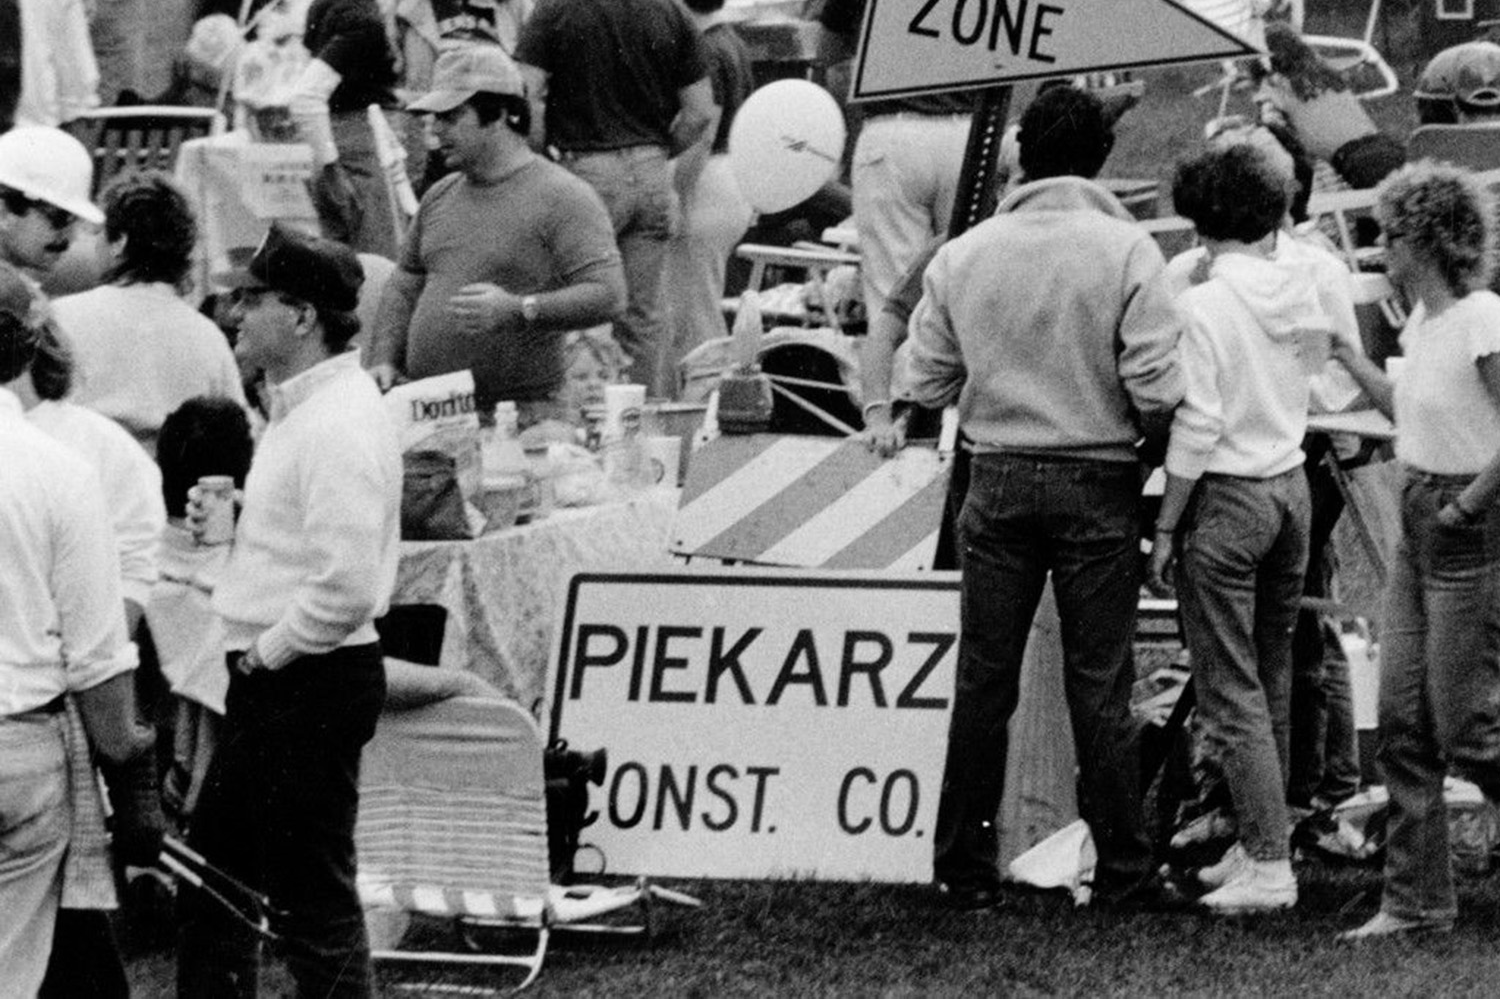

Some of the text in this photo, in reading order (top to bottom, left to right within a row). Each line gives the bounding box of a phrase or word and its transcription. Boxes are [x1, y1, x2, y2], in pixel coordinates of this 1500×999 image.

[569, 623, 958, 710] PIEKARZ
[584, 761, 925, 838] ONST. CO.
